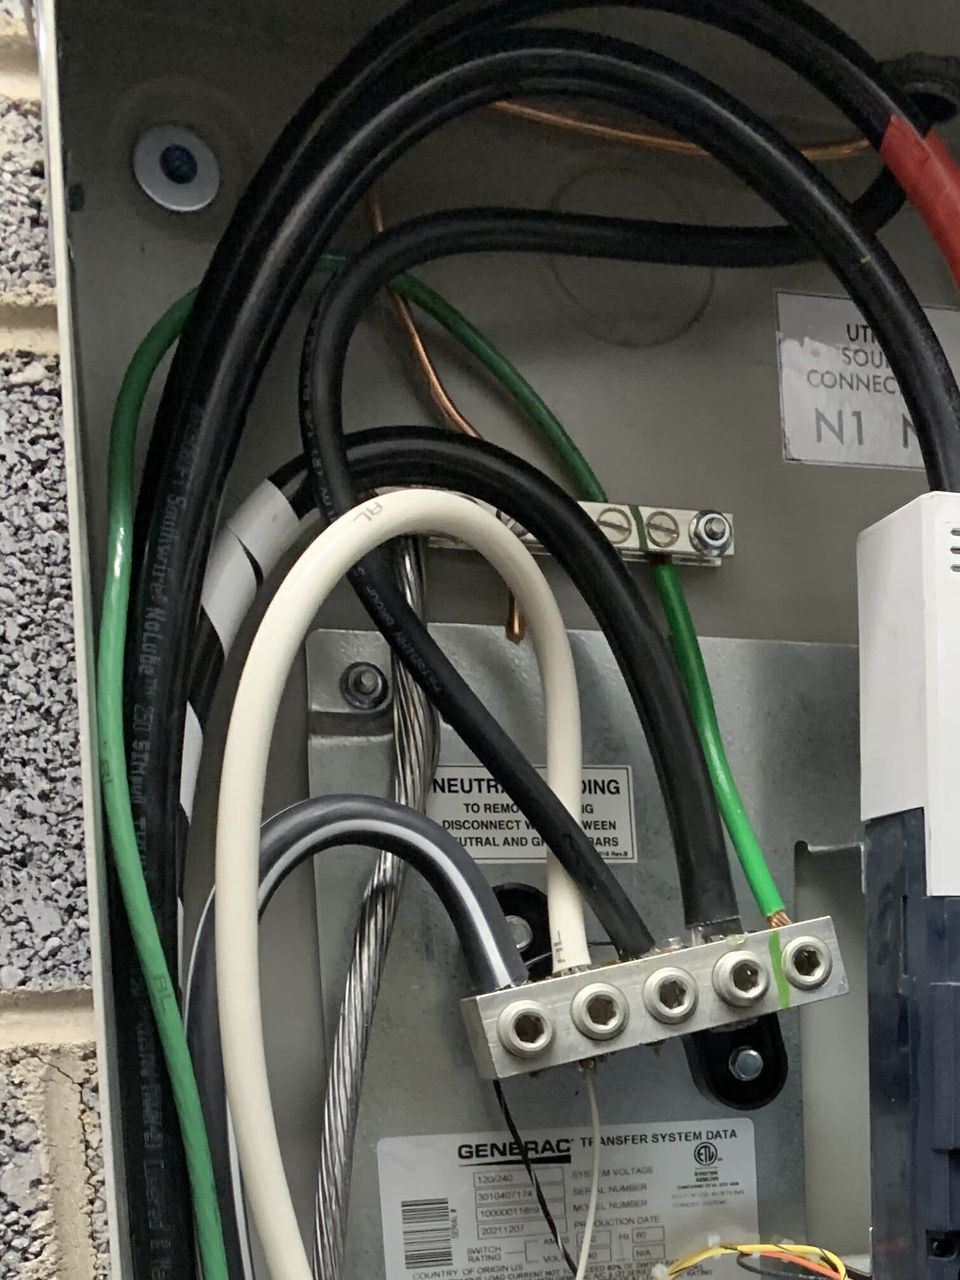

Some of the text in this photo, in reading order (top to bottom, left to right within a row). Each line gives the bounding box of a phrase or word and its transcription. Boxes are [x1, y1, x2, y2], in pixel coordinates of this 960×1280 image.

[807, 369, 895, 395] CONNEC
[815, 407, 864, 446] N1
[464, 803, 519, 813] TO REMO
[442, 820, 616, 830] DISCONNECT WEEN
[502, 836, 528, 847] AND
[651, 1131, 702, 1143] SYSTEM
[706, 1129, 737, 1140] DATA
[614, 1166, 653, 1177] VOLTAGE
[609, 1183, 647, 1193] NUMBER
[609, 1200, 647, 1210] NUMBER
[637, 1215, 660, 1225] DATE
[412, 1270, 457, 1280] COUNTRY
